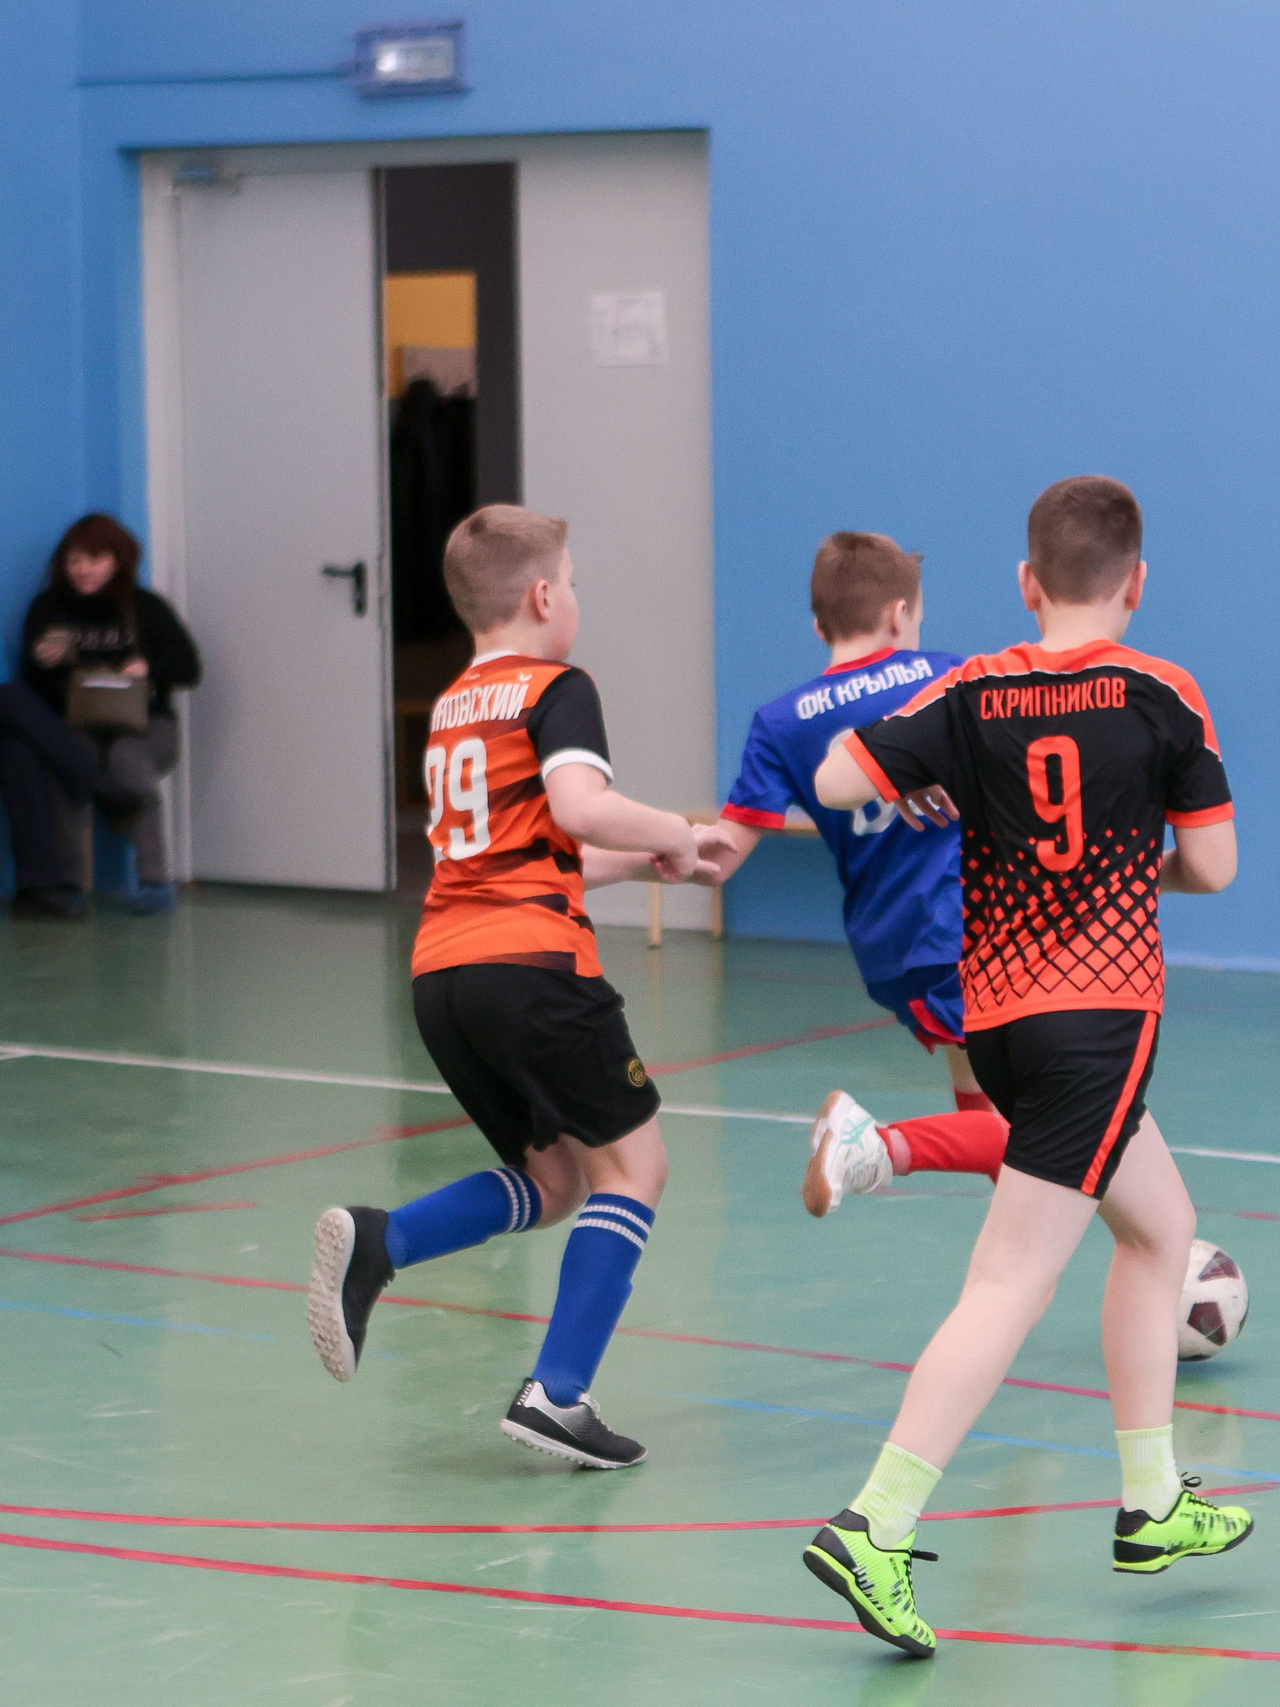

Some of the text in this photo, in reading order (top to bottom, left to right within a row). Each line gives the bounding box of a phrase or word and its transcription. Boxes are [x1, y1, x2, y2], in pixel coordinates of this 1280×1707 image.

[430, 673, 532, 733] НОВСКИЙ
[796, 658, 933, 720] ФК КРЫЛЬЯ
[981, 676, 1126, 720] СКРИПНИКОВ
[1027, 735, 1084, 872] 9
